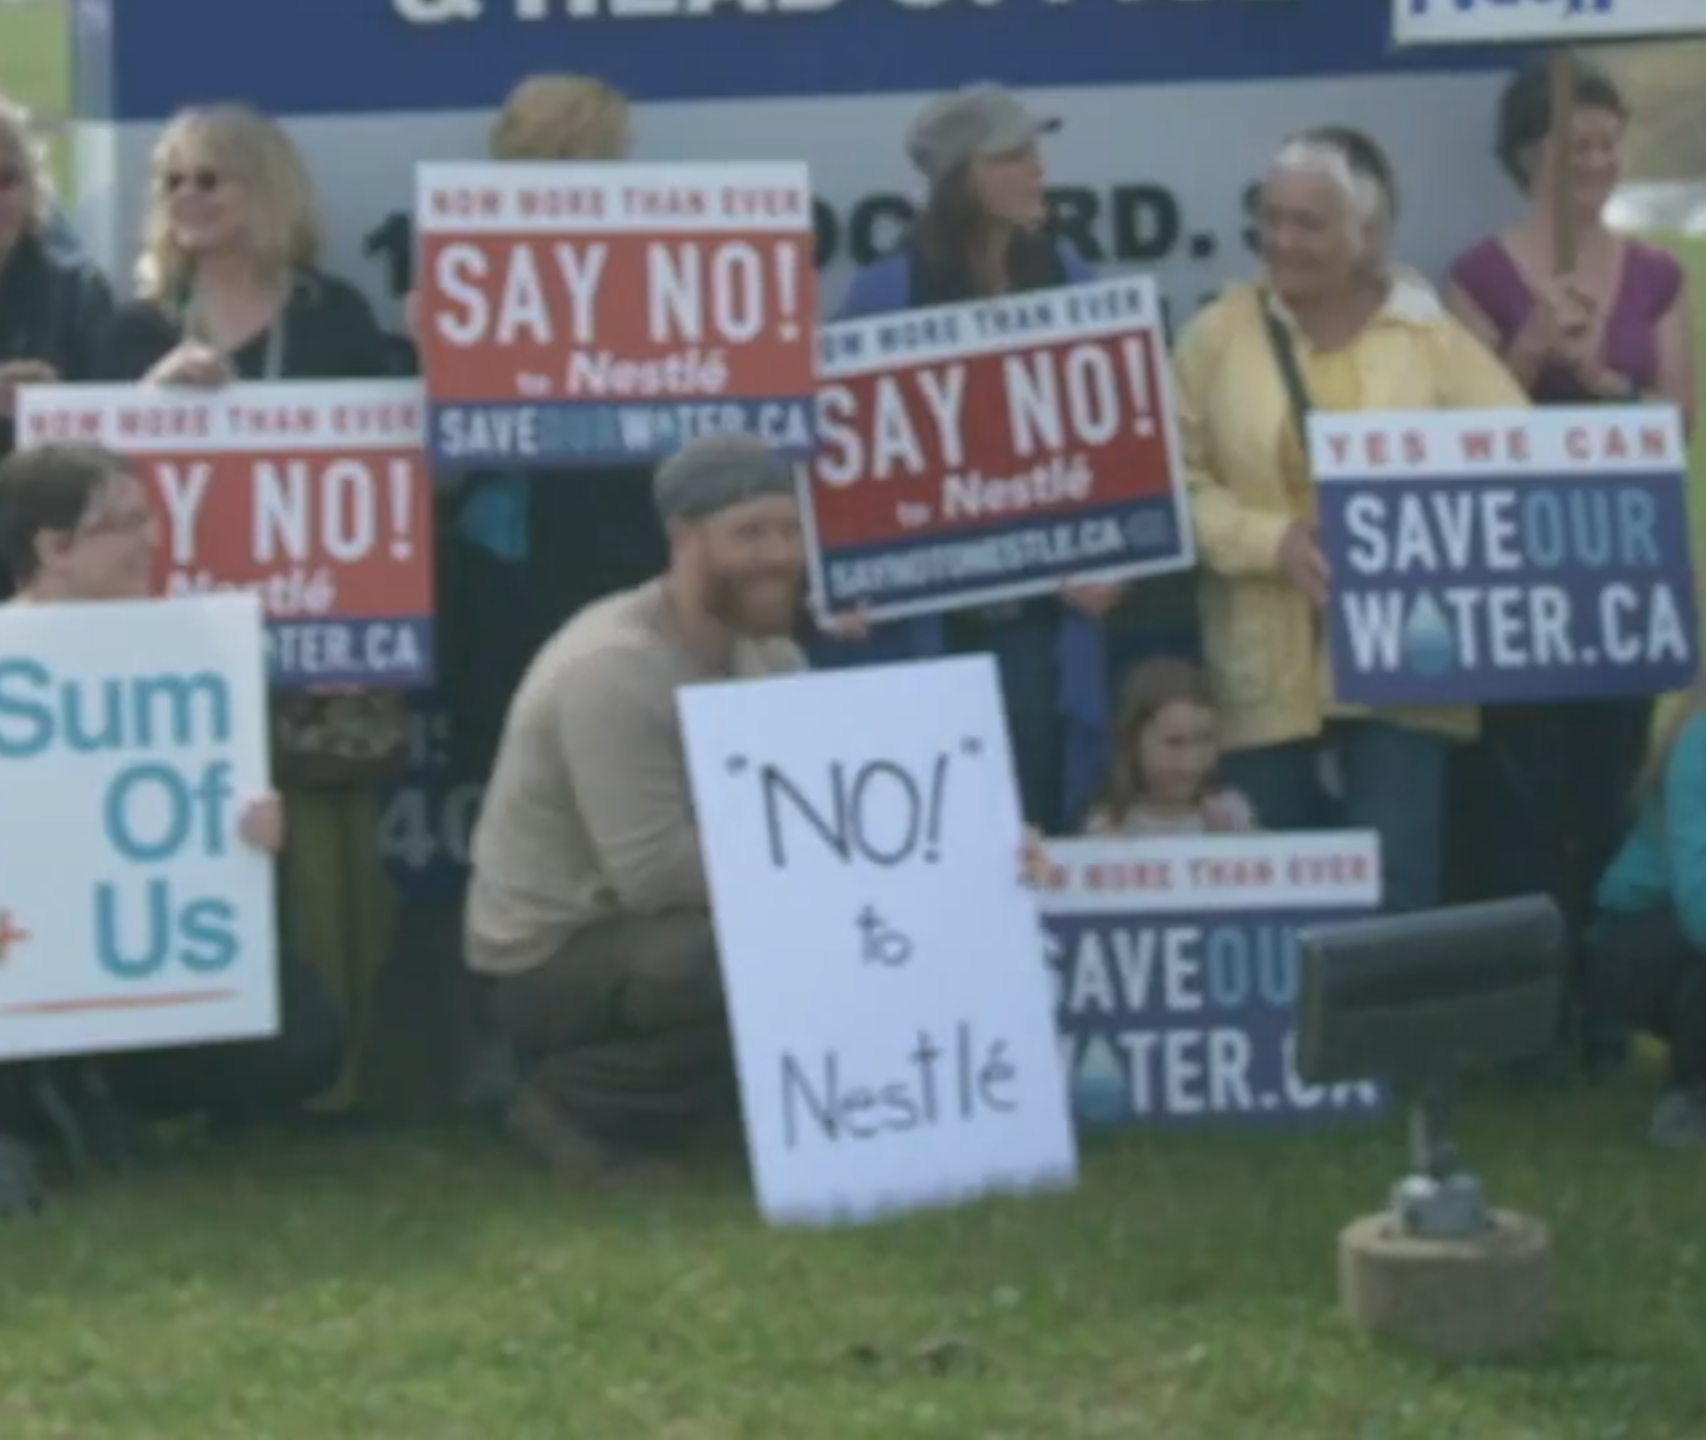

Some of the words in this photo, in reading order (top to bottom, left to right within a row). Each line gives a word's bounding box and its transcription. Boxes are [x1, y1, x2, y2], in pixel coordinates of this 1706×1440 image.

[432, 187, 503, 217] NOW
[517, 187, 604, 217] MORE
[623, 187, 707, 216] THAN
[721, 186, 803, 216] EVER
[436, 243, 607, 347] SAY
[647, 241, 799, 343] NO!
[878, 316, 959, 351] MORE
[974, 302, 1053, 338] THAN
[1068, 287, 1142, 323] EVER
[568, 348, 727, 395] Nestlé
[29, 410, 102, 437] NOW
[118, 406, 209, 436] MORE
[228, 405, 316, 435] THAN
[331, 402, 419, 431] EVER
[815, 364, 966, 487] SAY
[1002, 337, 1154, 457] NO!
[1327, 430, 1426, 466] YES
[1460, 429, 1530, 462] WE
[1563, 426, 1667, 459] CAN
[252, 459, 414, 563] NO!
[943, 452, 1093, 520] Nestlé
[104, 760, 233, 863] Of
[1084, 862, 1172, 891] MORE
[1190, 858, 1274, 888] THAN
[1286, 854, 1369, 885] EVER
[96, 877, 239, 978] Us
[855, 904, 912, 965] to
[780, 1020, 1016, 1149] Nestlé
